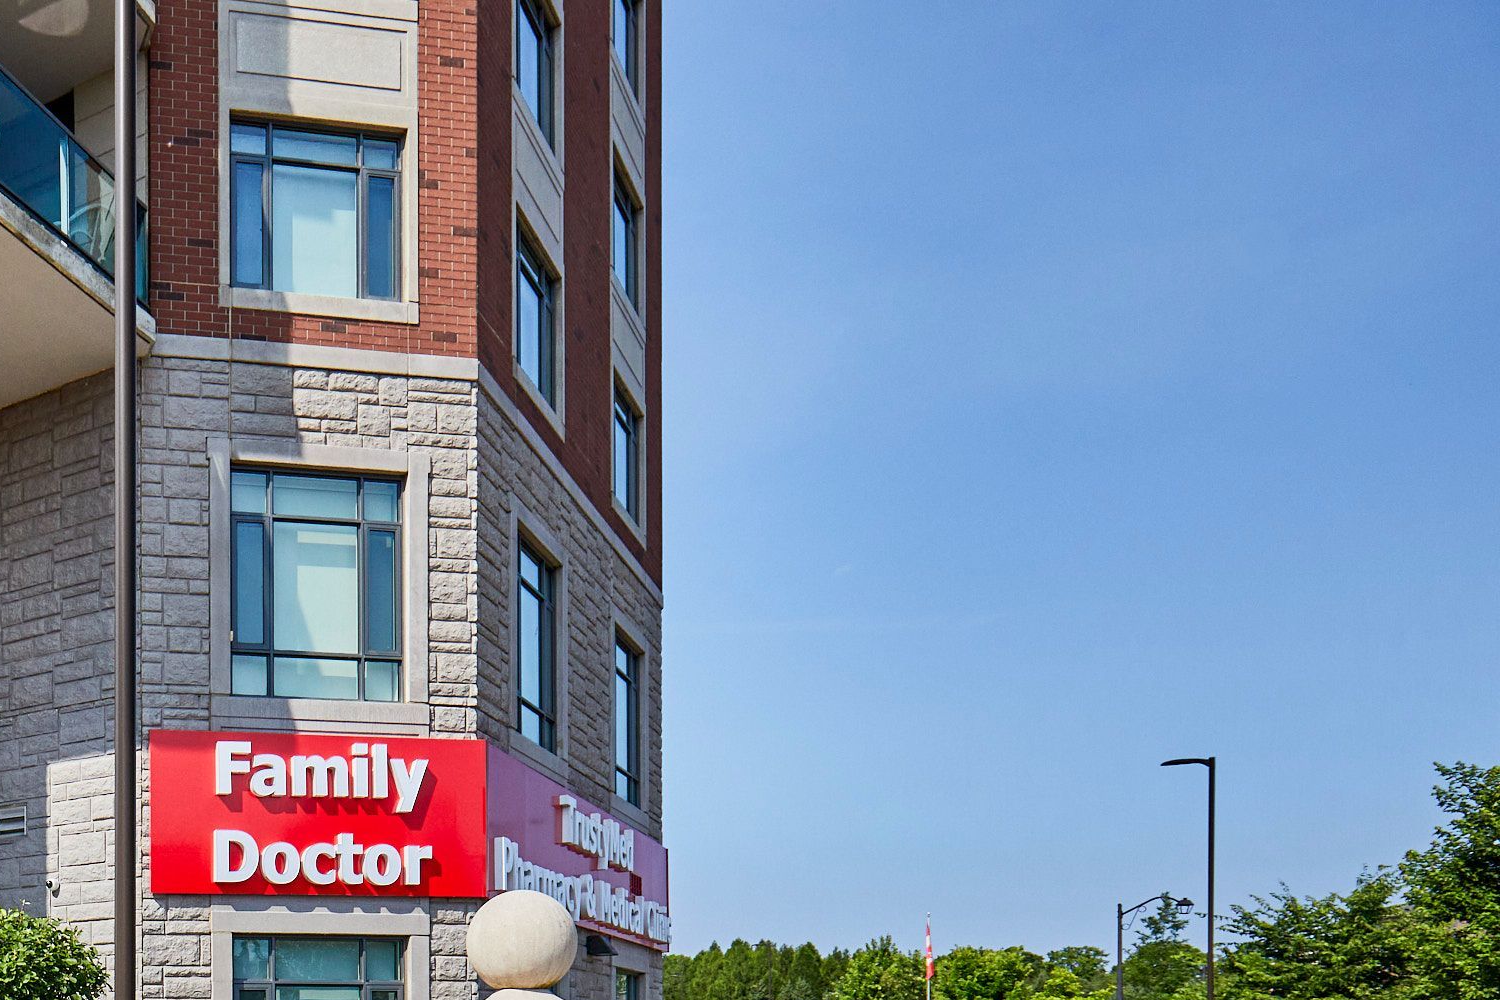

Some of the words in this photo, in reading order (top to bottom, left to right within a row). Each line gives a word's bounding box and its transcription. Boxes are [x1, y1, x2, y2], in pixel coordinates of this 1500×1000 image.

[215, 740, 430, 813] Family
[213, 829, 432, 886] Doctor
[560, 794, 633, 871] TrustyMed
[580, 874, 596, 918] &
[594, 880, 644, 935] Medical
